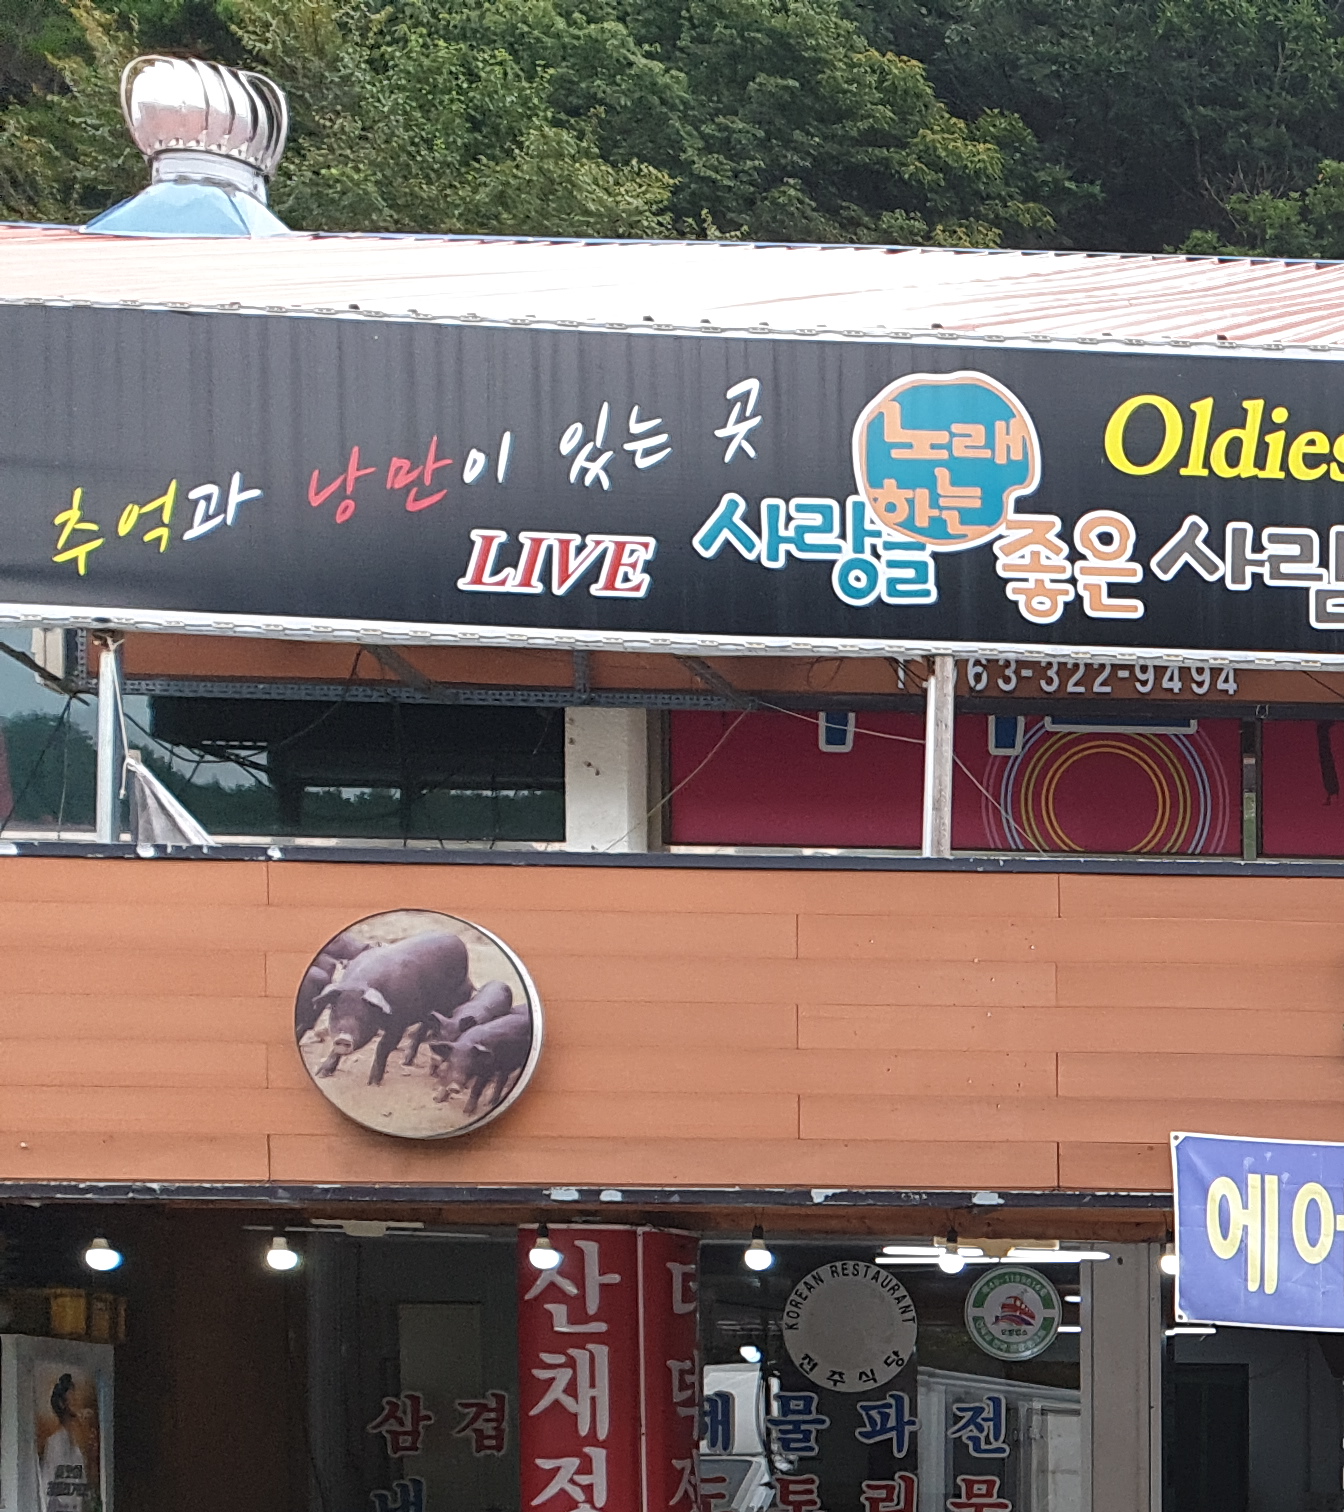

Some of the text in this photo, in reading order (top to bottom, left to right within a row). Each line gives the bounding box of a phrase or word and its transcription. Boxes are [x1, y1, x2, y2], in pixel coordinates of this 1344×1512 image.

[880, 399, 1030, 466] 노래
[51, 470, 263, 577] 추억과
[558, 400, 674, 492] 있는
[711, 376, 763, 463] 곳
[456, 529, 658, 599] LIVE
[997, 510, 1145, 625] 좋은
[784, 1271, 825, 1331] KOREAN
[829, 1262, 917, 1325] RESTAURANT
